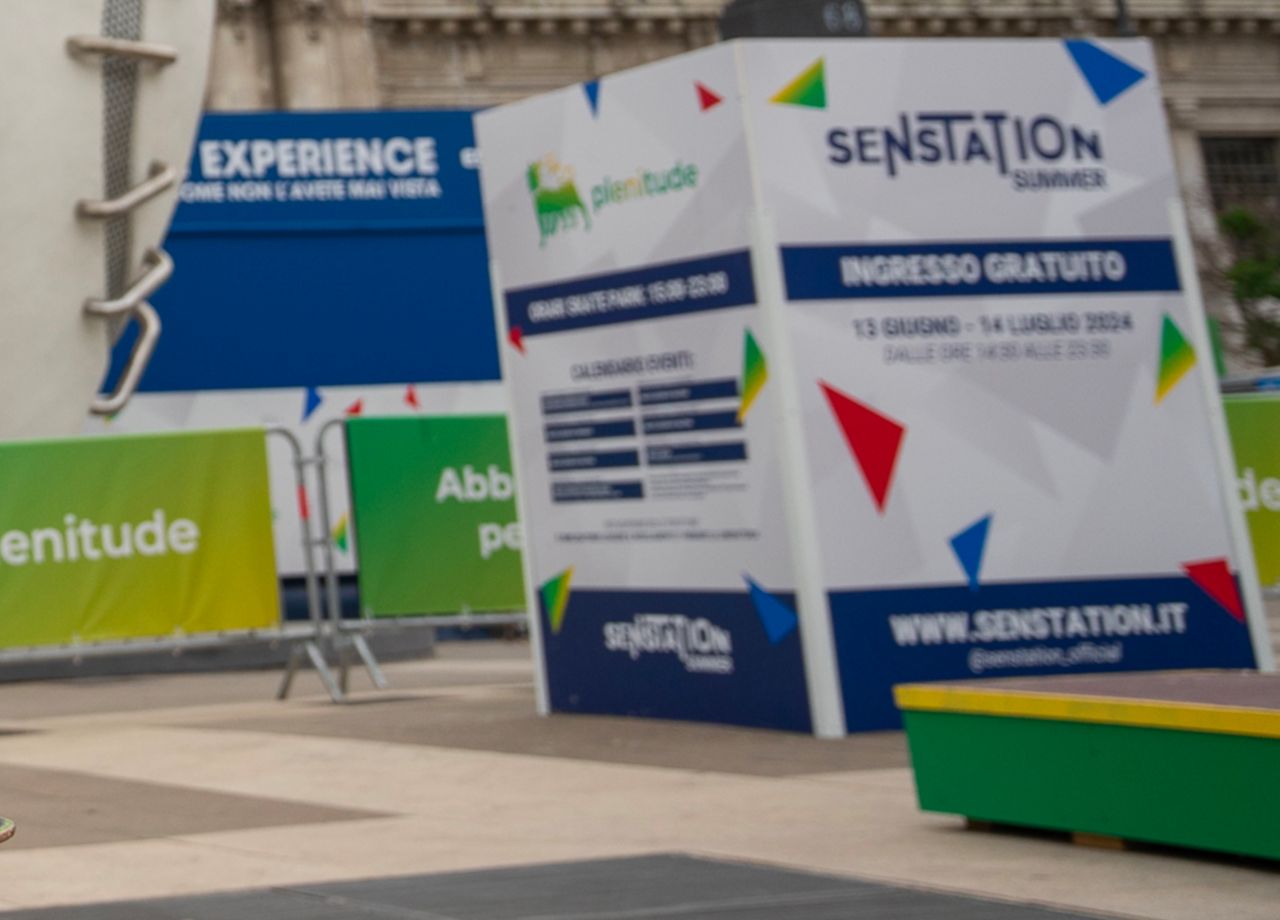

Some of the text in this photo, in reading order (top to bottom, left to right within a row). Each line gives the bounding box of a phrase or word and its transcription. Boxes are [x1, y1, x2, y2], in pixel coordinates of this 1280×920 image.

[199, 137, 438, 179] EXPERIENCE
[827, 112, 1103, 177] SENSTATION
[179, 181, 225, 202] OME
[227, 180, 273, 202] NON
[348, 178, 385, 200] MAI
[591, 159, 698, 214] plenitude
[1011, 168, 1107, 190] SUMMER
[839, 250, 1126, 286] INGRESSO GRATUITO
[882, 315, 961, 338] GIUGNO
[1007, 312, 1081, 335] LUGLIO
[889, 602, 1188, 646] WWW.SENSTATION.IT
